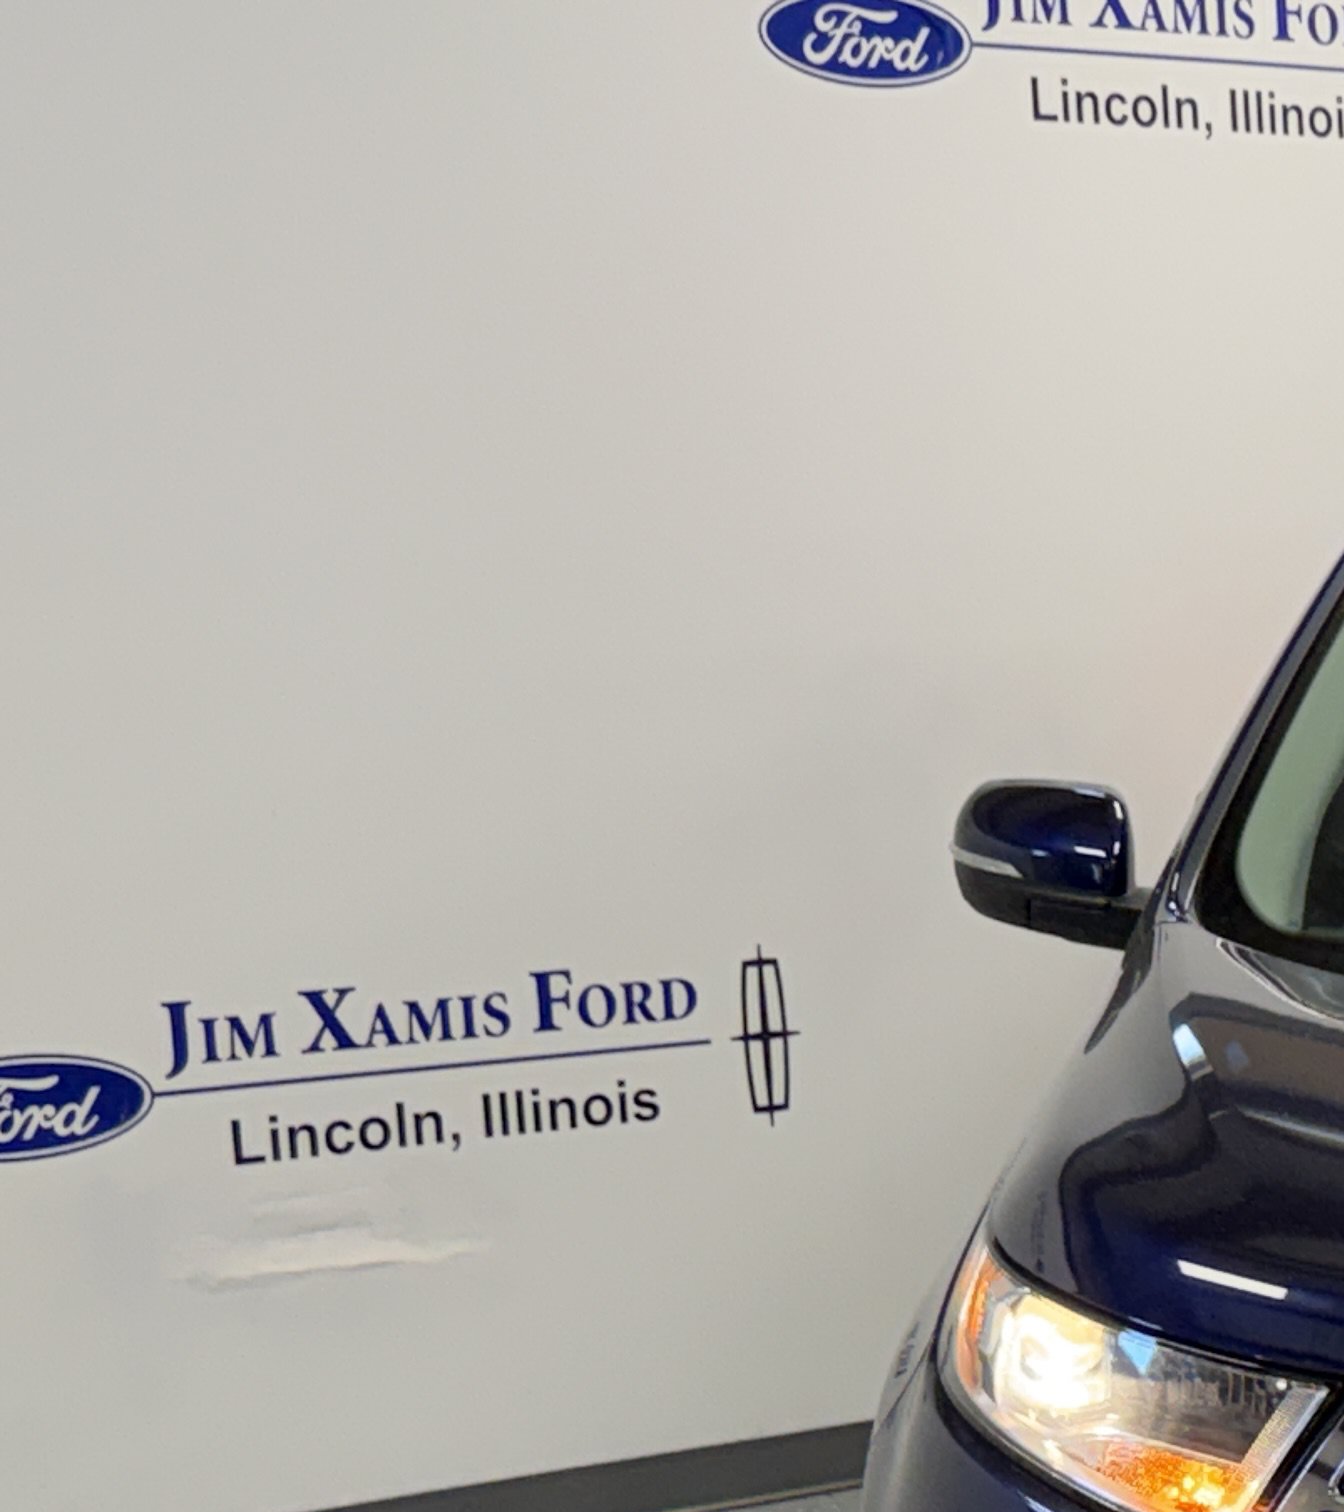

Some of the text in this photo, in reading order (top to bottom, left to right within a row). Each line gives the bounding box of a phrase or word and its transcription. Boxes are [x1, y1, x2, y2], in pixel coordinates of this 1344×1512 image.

[803, 2, 930, 73] Ford
[1030, 76, 1213, 139] Lincoln,
[161, 969, 698, 1079] JIM XAMIS FORD
[229, 1078, 661, 1166] Lincoln, Illinois
